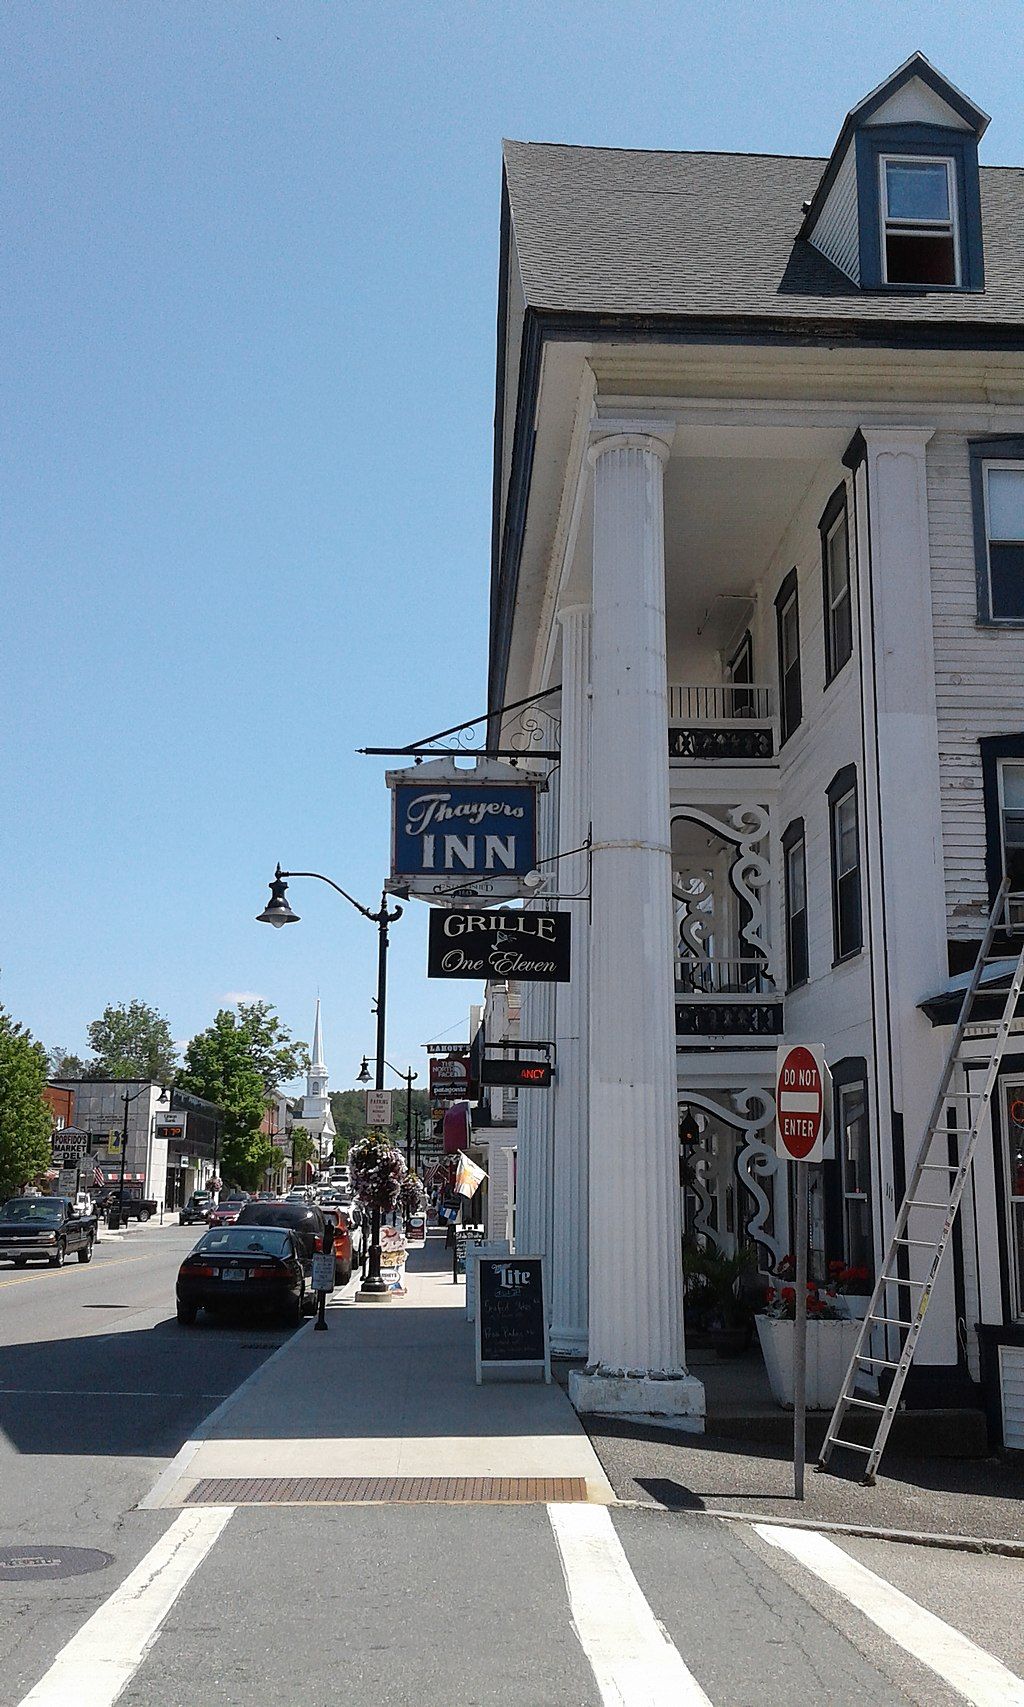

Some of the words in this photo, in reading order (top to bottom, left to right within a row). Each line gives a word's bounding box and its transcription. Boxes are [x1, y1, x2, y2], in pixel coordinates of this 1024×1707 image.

[405, 792, 525, 836] Thayers
[422, 833, 516, 870] INN
[443, 914, 556, 943] GRILLE
[441, 949, 484, 972] One
[488, 950, 556, 974] Eleven
[432, 1066, 454, 1074] NORTH
[784, 1069, 795, 1086] DO
[799, 1069, 817, 1086] NOT
[433, 1086, 466, 1095] patagonia
[784, 1119, 814, 1138] ENTER
[54, 1135, 87, 1145] PORFIDO'S
[54, 1144, 87, 1152] MARKET
[493, 1264, 531, 1289] Lite
